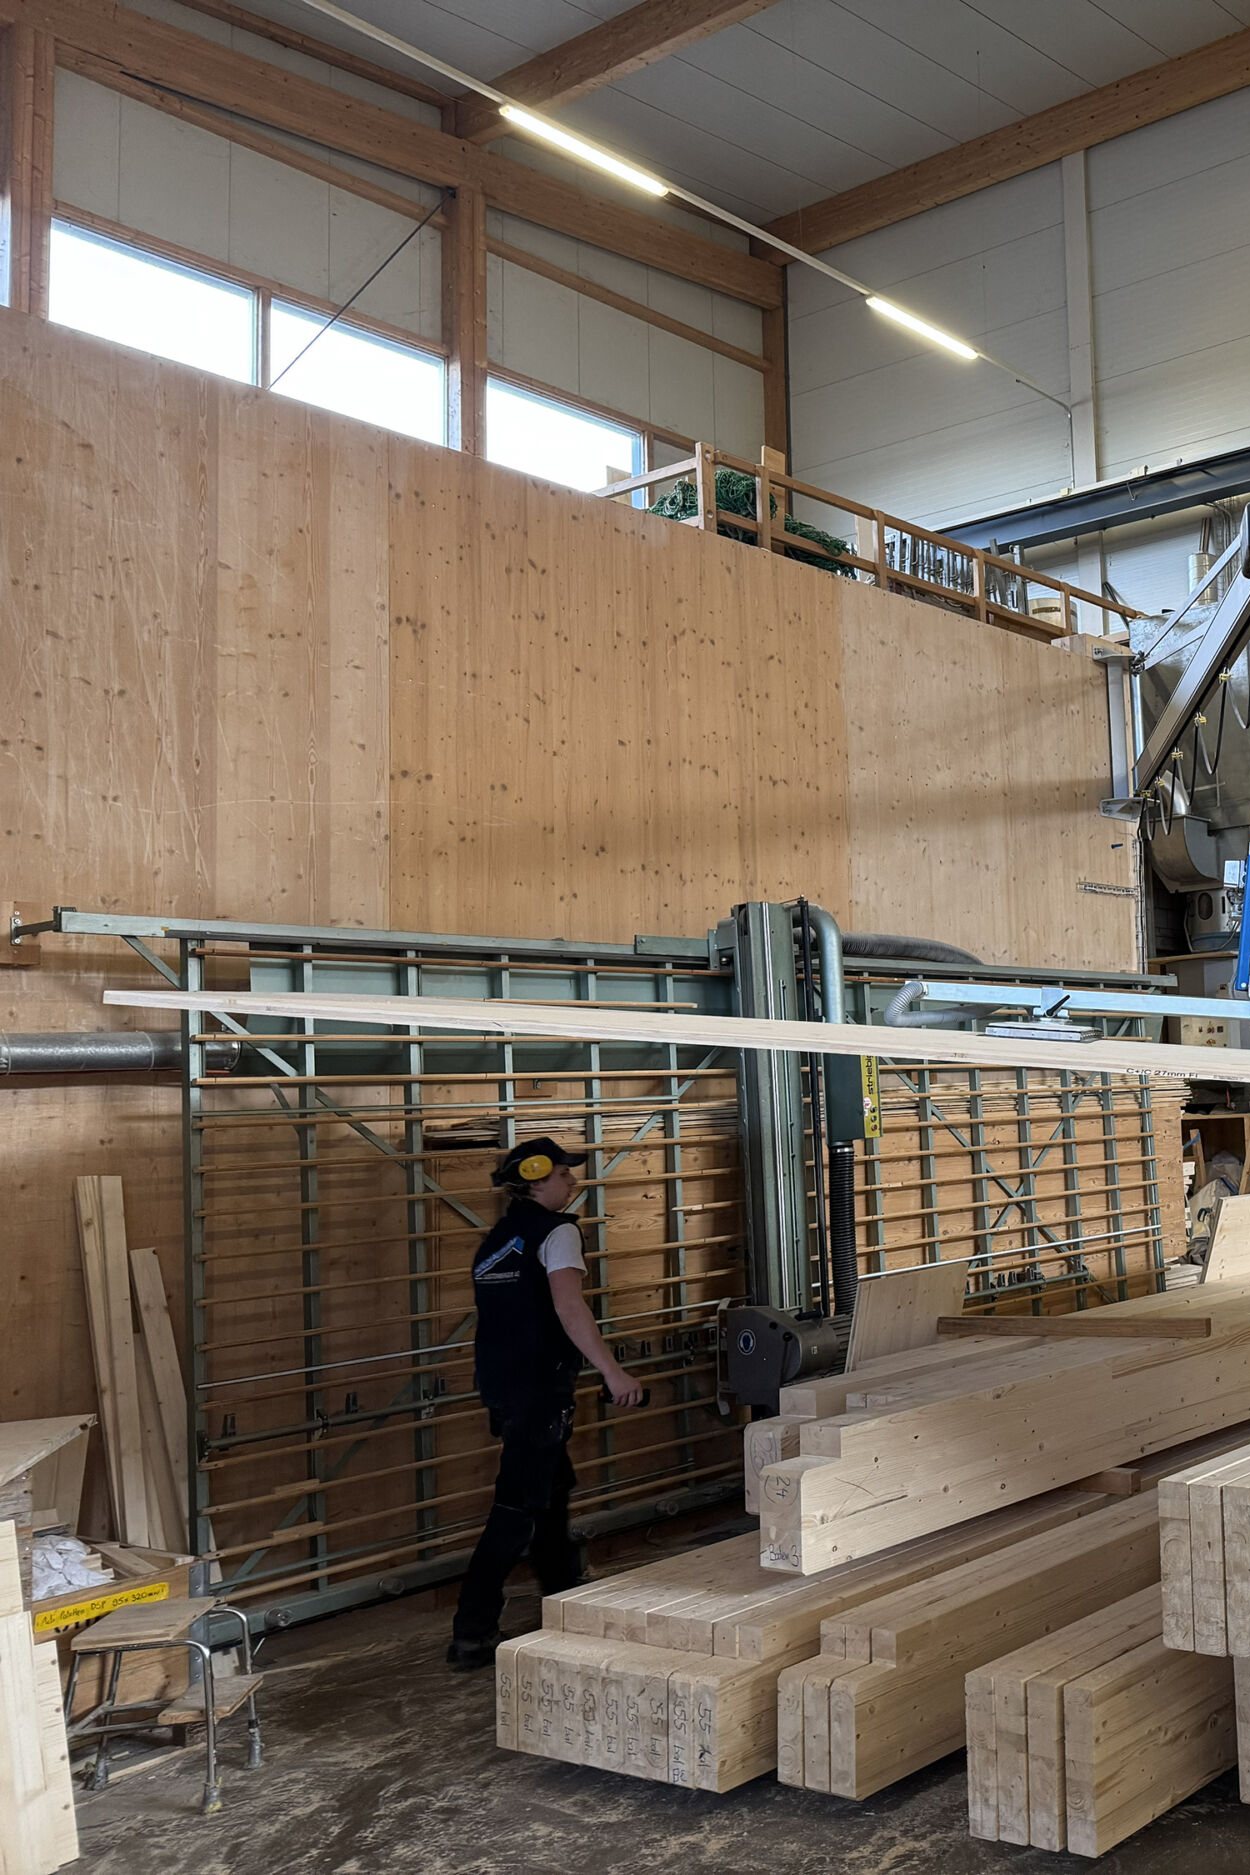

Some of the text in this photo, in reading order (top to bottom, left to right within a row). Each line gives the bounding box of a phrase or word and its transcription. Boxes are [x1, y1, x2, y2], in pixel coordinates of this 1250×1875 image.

[1154, 1069, 1186, 1078] 27mm
[776, 1476, 791, 1499] 24
[501, 1672, 512, 1700] 55
[521, 1675, 533, 1704] 55
[541, 1679, 554, 1713] 55
[562, 1683, 575, 1713] 55
[605, 1691, 618, 1726] 55
[626, 1695, 639, 1725] 55
[650, 1697, 664, 1729] 55
[698, 1701, 713, 1735] 55
